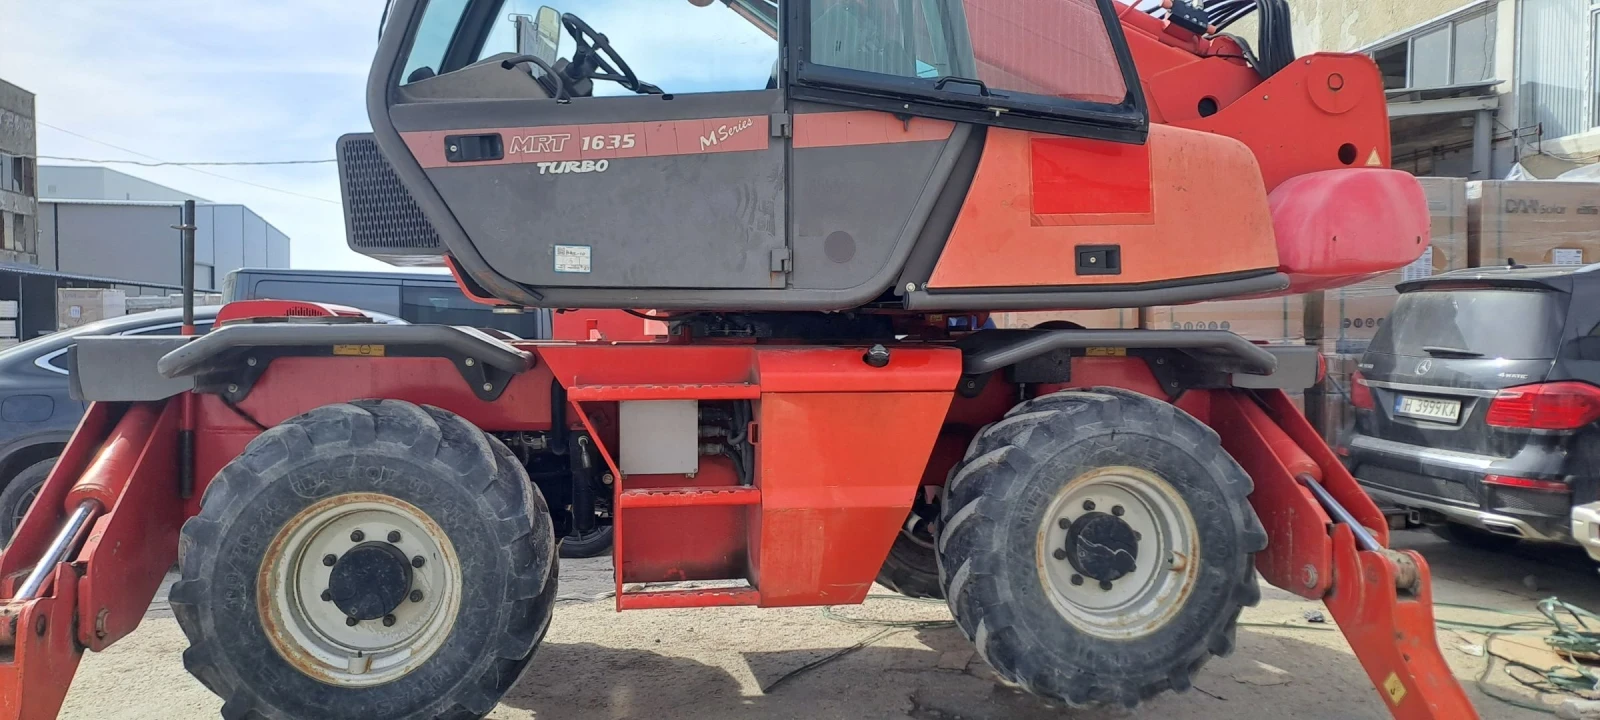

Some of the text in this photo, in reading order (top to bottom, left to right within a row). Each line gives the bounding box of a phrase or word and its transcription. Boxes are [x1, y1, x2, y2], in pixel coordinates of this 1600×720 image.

[509, 133, 636, 154] MRT 1635
[700, 118, 753, 151] M Series
[537, 159, 609, 175] TURBO
